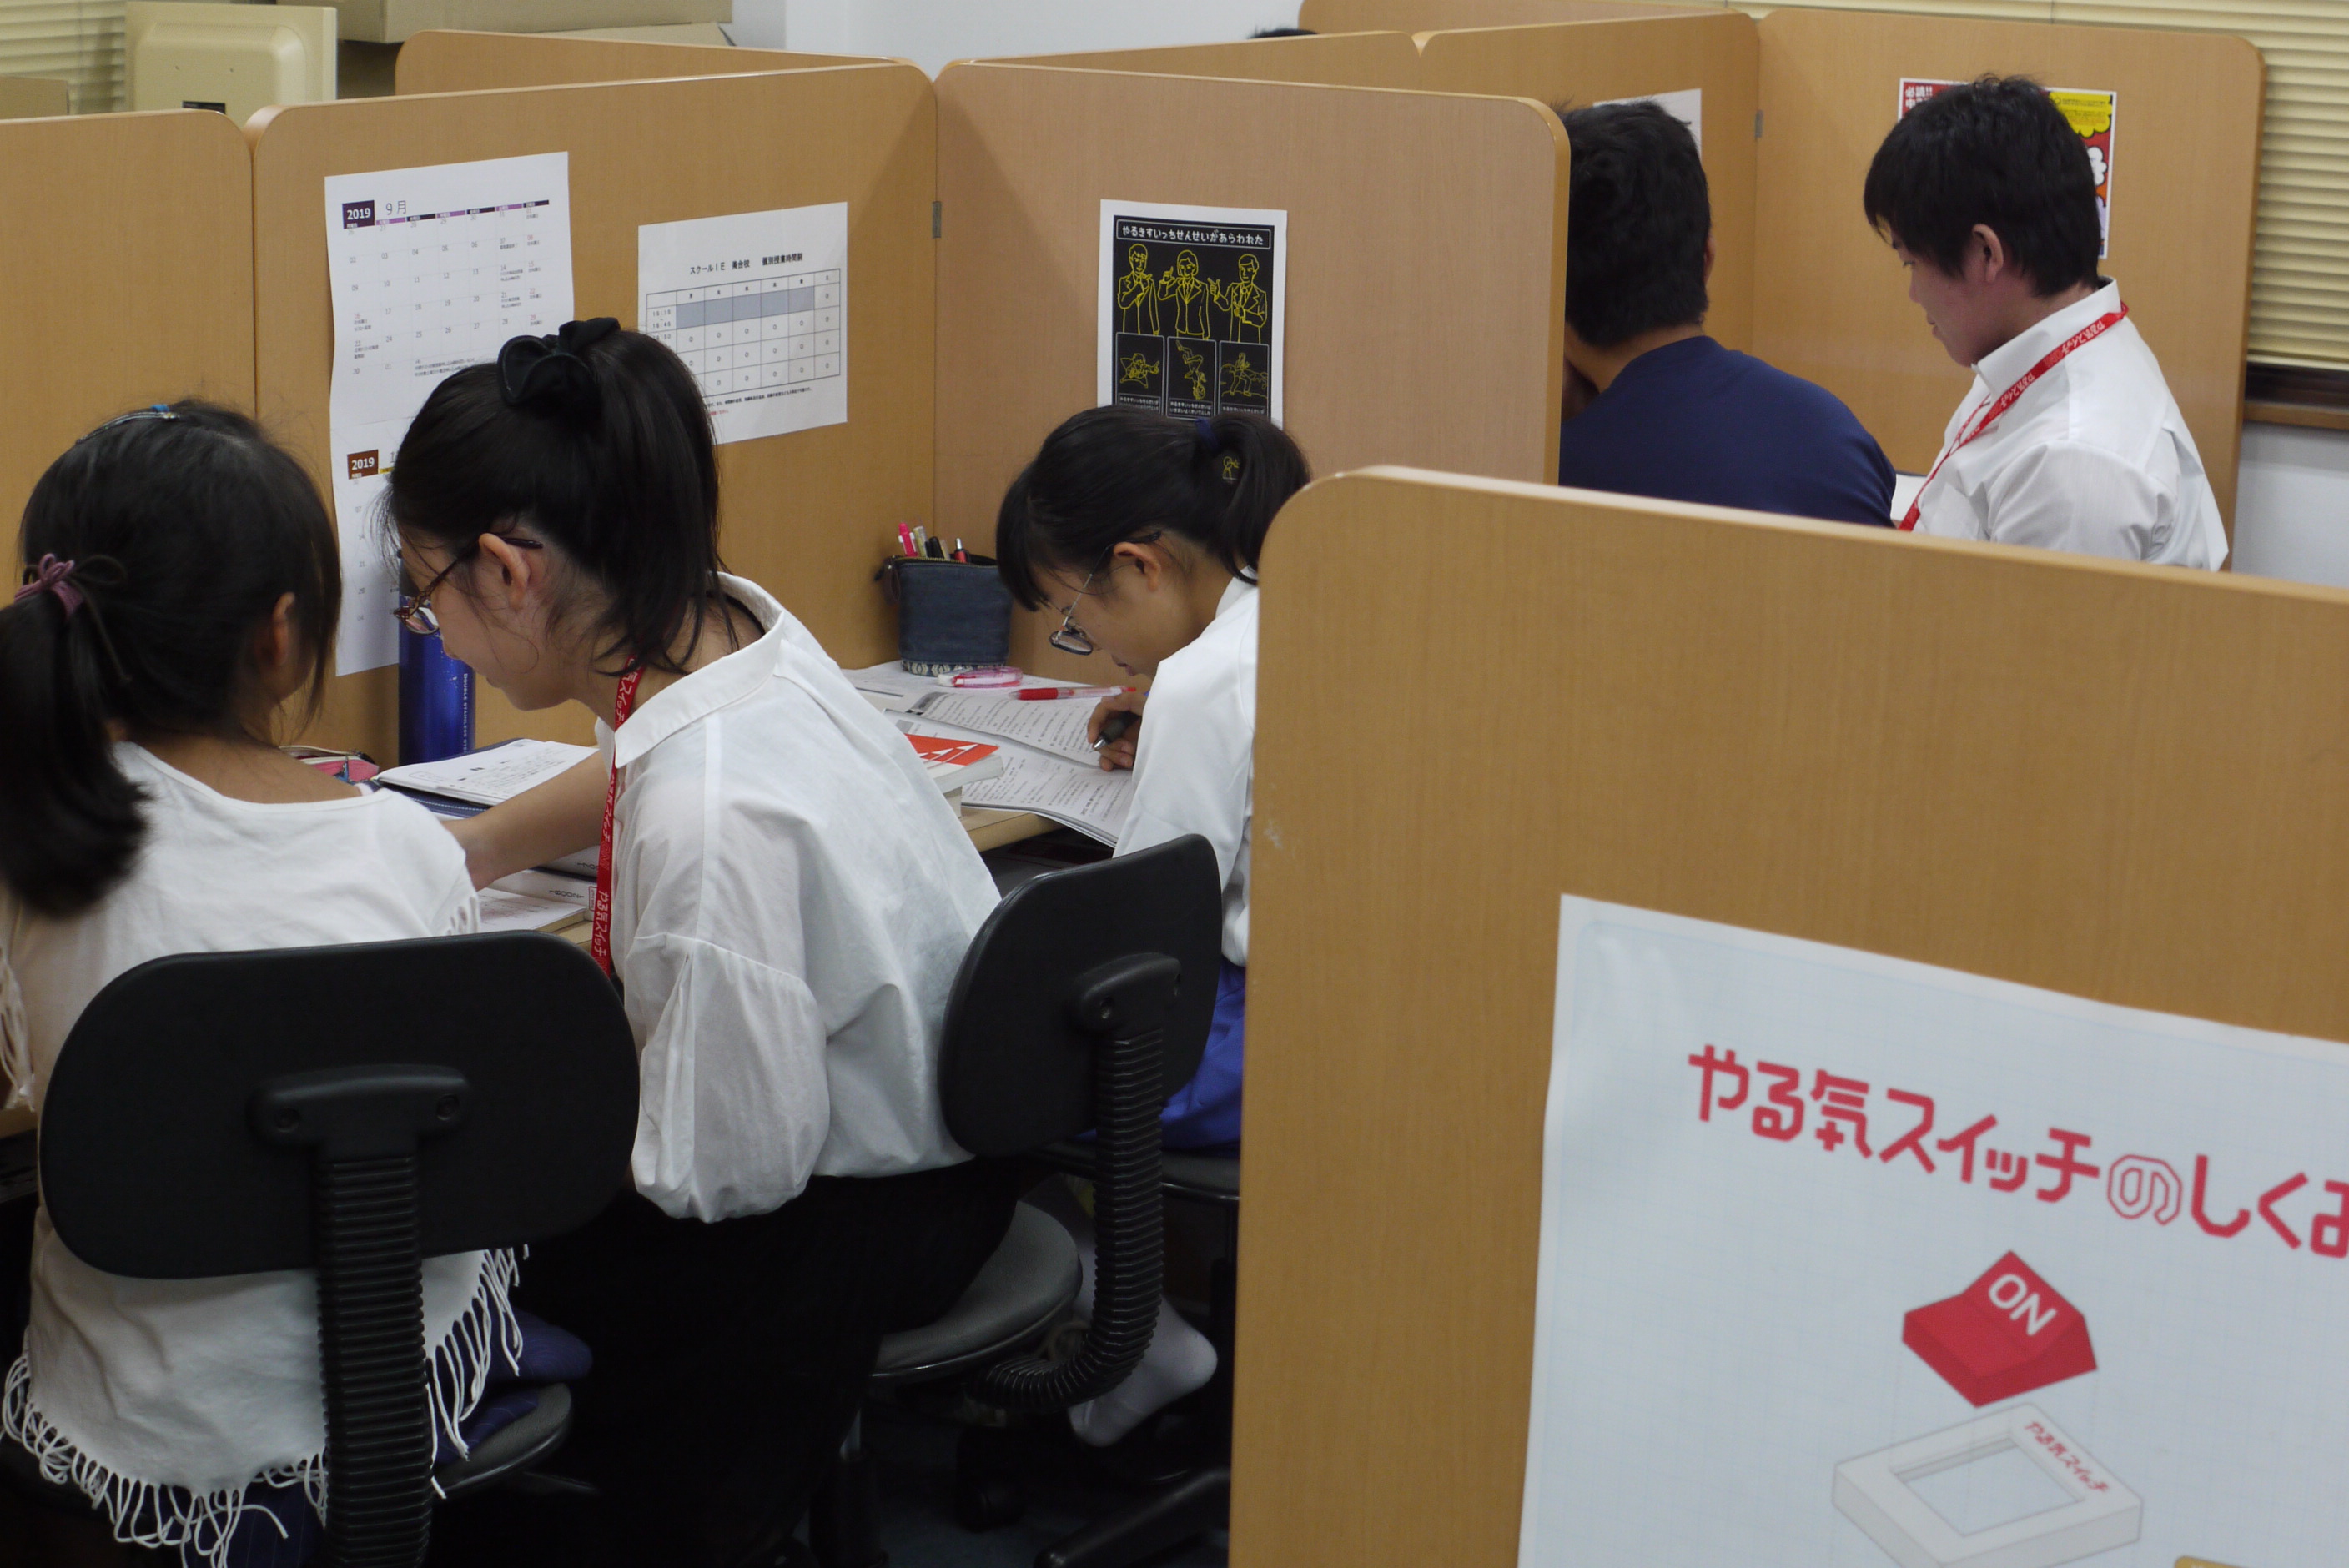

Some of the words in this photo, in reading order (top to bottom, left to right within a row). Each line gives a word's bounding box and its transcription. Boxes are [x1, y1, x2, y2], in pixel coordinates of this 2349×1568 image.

[347, 208, 371, 220] 2019
[385, 200, 407, 215] 9月
[1122, 225, 1264, 245] やるきすいっちせんせいがあらわれた
[351, 456, 375, 470] 2019
[594, 890, 611, 957] やる気スイッチ
[1988, 1274, 2057, 1336] ON
